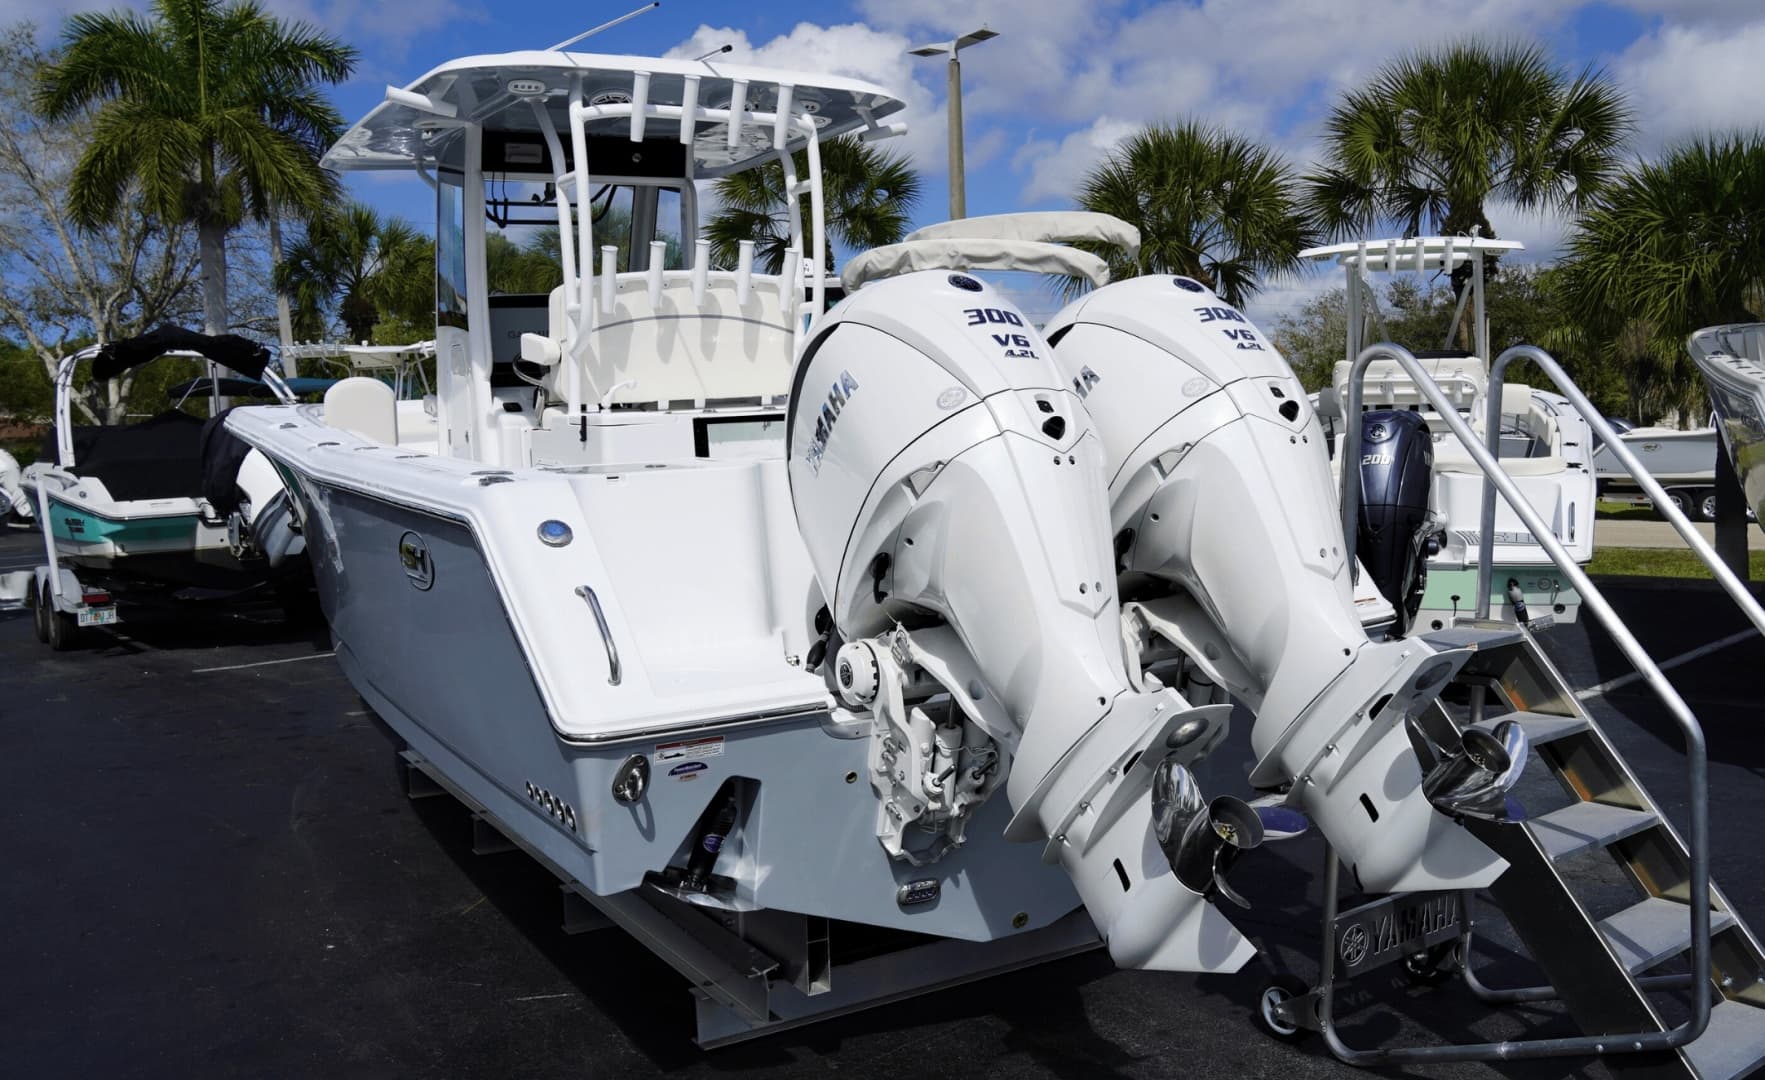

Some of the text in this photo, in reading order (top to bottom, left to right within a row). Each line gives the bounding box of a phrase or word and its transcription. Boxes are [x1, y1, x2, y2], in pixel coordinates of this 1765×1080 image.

[963, 308, 1024, 327] 300
[1193, 307, 1246, 323] 300
[992, 334, 1030, 347] V6
[1222, 329, 1256, 341] V6
[1004, 349, 1039, 360] 4.2L
[805, 369, 860, 479] YAMAHA
[1362, 454, 1392, 465] 200
